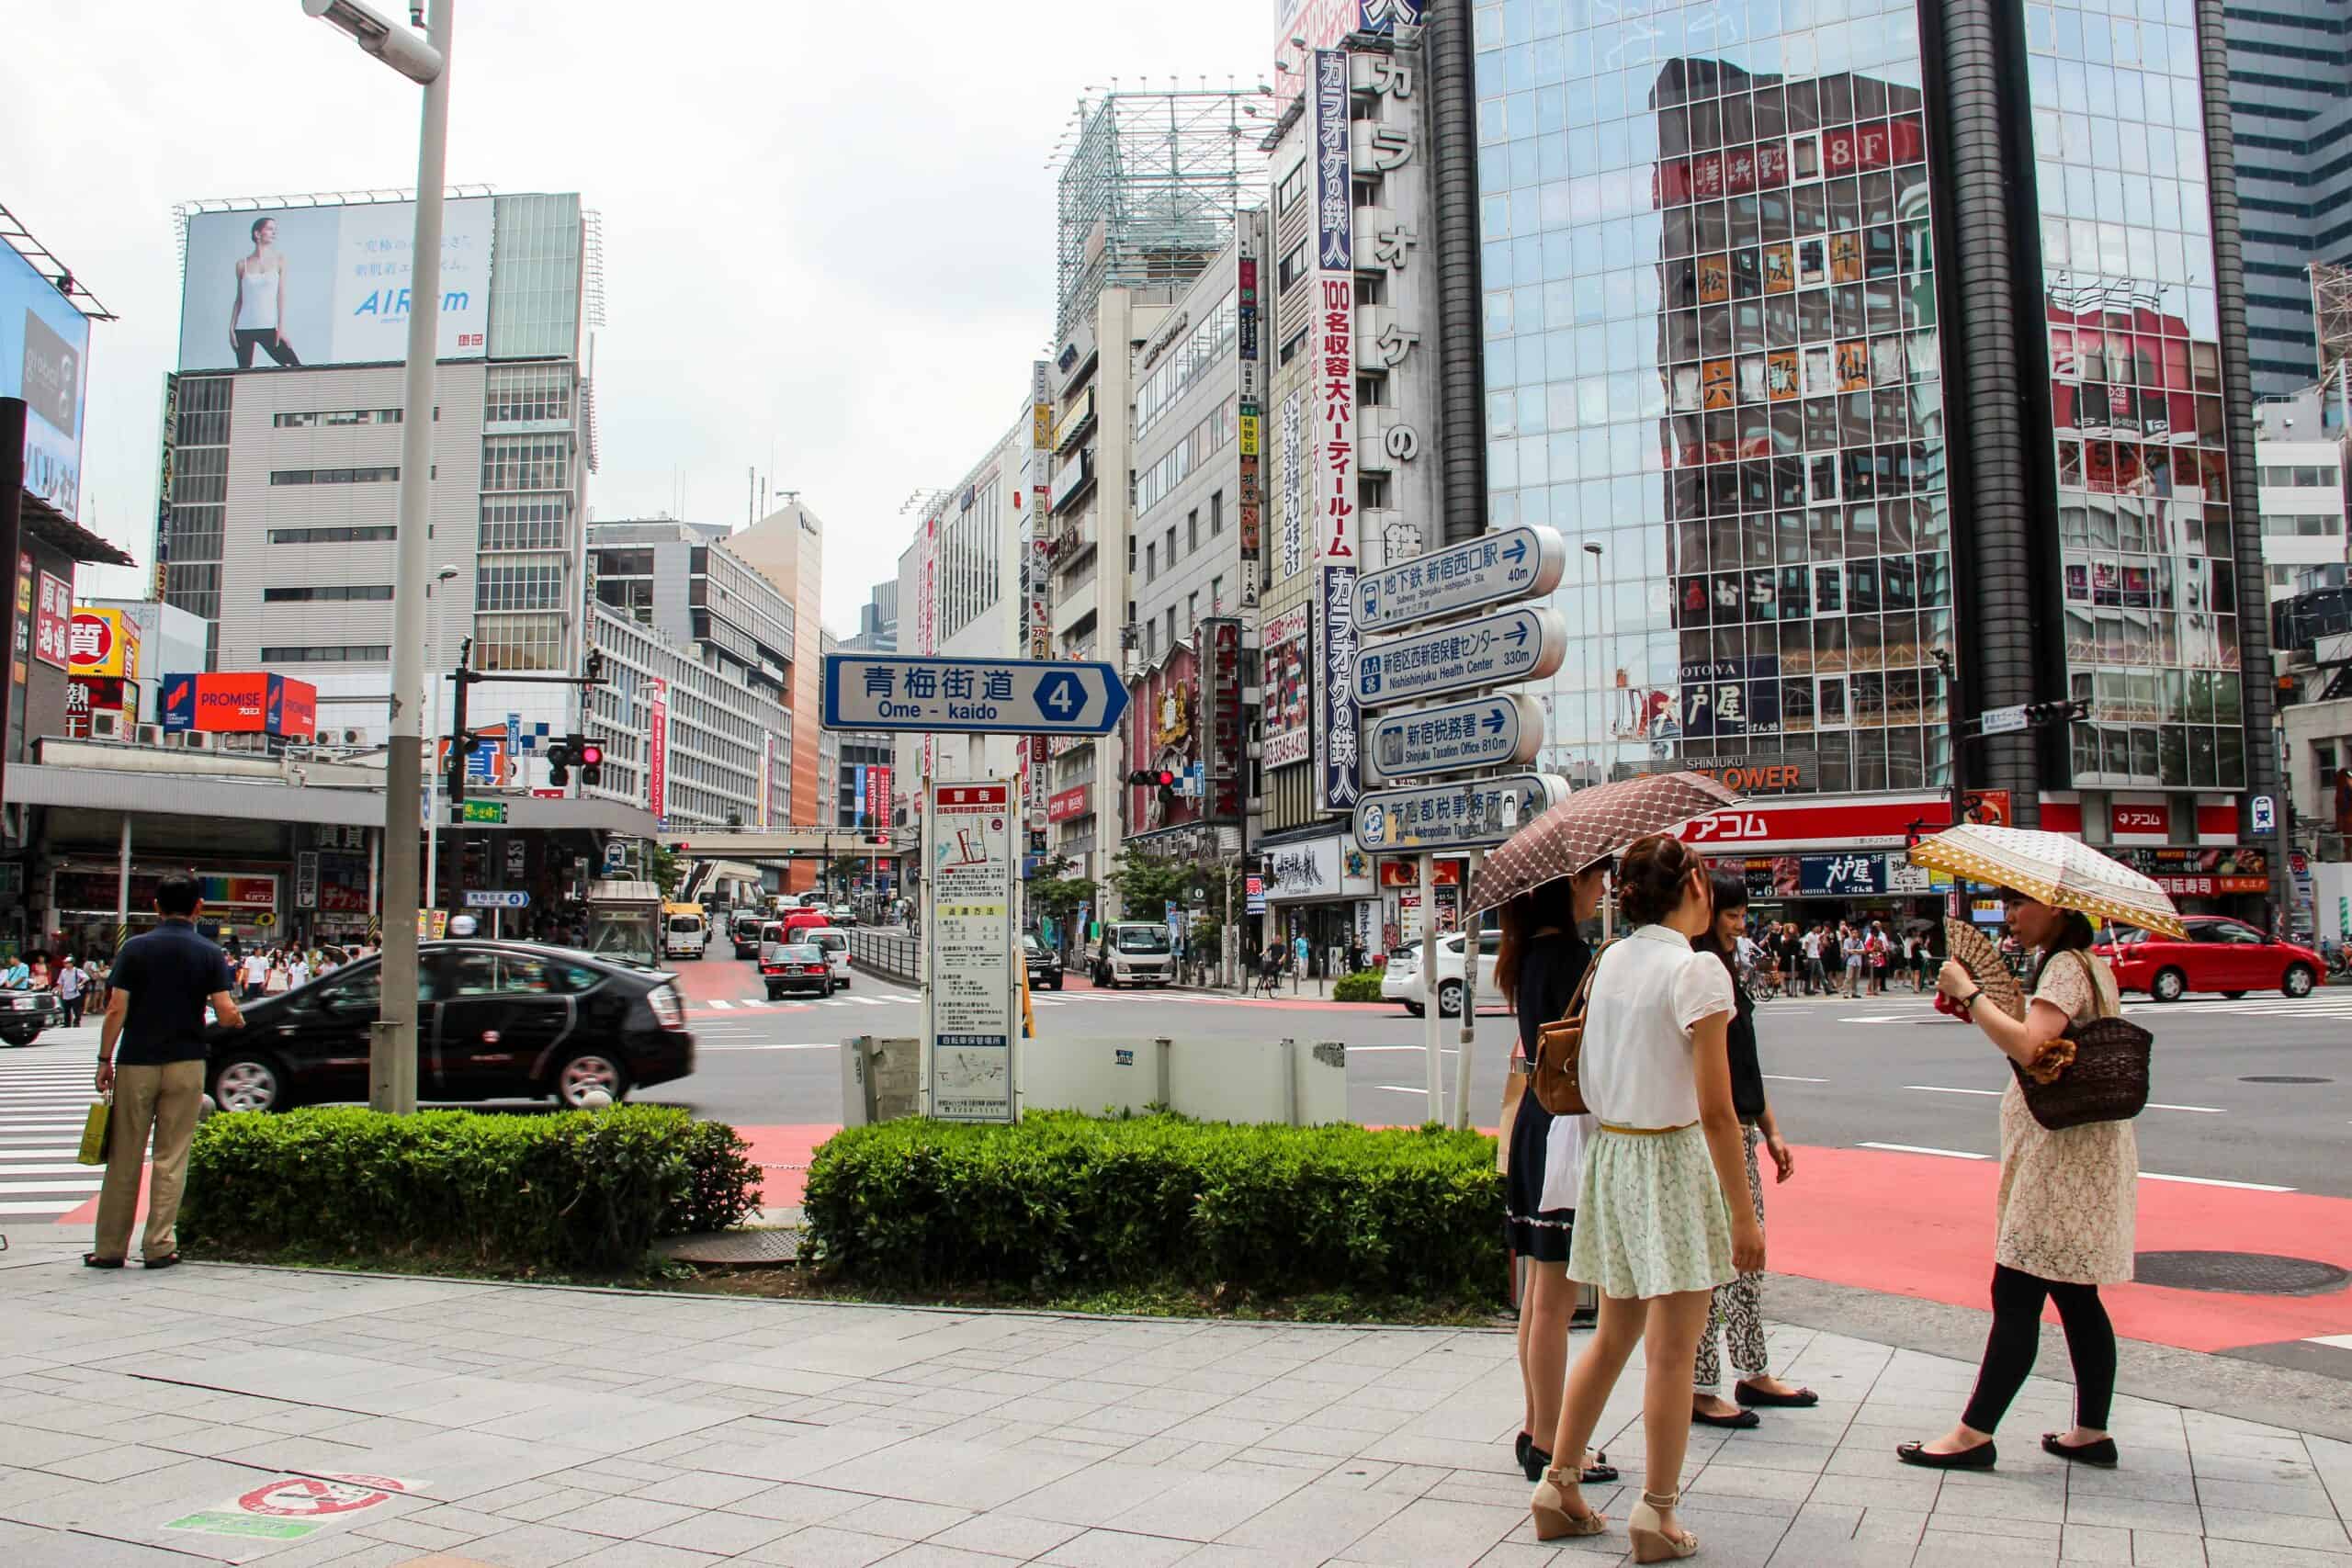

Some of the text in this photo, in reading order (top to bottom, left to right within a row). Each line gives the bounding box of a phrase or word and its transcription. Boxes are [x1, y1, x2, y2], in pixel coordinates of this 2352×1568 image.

[1320, 52, 1349, 269] カラオケの鉄人
[355, 288, 469, 315] AIRm
[1322, 280, 1352, 558] 100名収容大パーティールーム
[1385, 542, 1498, 596] 地下鉄 新宿西口駅
[1508, 567, 1528, 581] 40m
[70, 623, 102, 657] 質
[1384, 630, 1500, 674] 新宿区西新宿保健センター
[1389, 658, 1493, 690] Nishishinjuku Health Center
[1504, 650, 1529, 666] 330m
[201, 693, 261, 706] PROMISE
[863, 666, 1014, 701] 青梅街道
[1048, 681, 1072, 714] 4
[1328, 567, 1358, 806] カラオケの鉄人
[878, 700, 921, 718] Ome
[948, 702, 997, 720] kaido
[1407, 714, 1476, 747] 新宿税務署
[1265, 731, 1307, 765] 03-3345-6430
[1405, 738, 1507, 764] Shinjuku Taxation Office 810m
[1687, 756, 1744, 770] SHINJUKU
[1696, 814, 1768, 840] アコム
[2131, 814, 2160, 825] アコム
[1826, 854, 1873, 888] 大戸屋
[1871, 854, 1883, 864] 3F
[2158, 878, 2211, 894] 回転寿司
